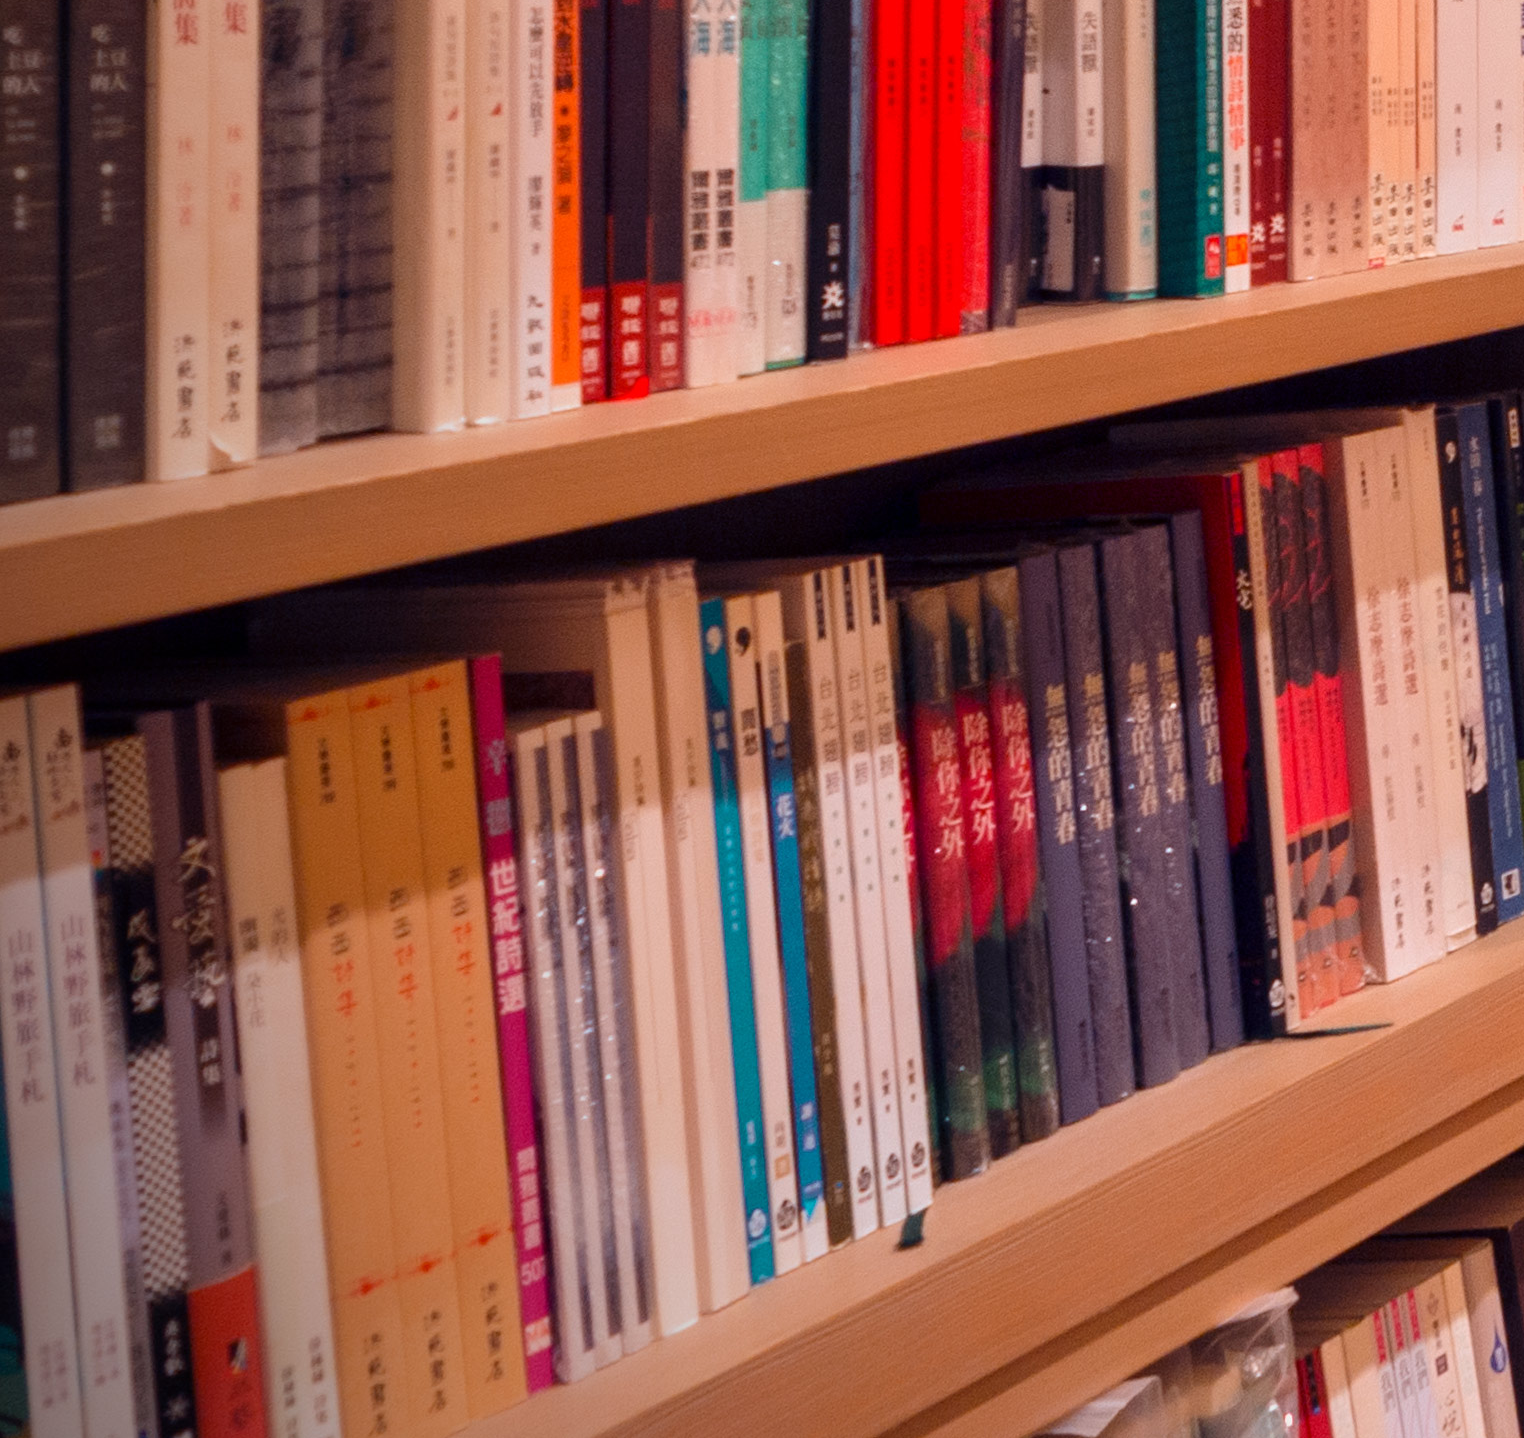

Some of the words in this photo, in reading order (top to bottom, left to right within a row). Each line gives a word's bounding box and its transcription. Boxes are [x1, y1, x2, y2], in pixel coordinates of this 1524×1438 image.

[930, 720, 965, 862] 除你之外
[962, 709, 997, 846] 除你之外
[1002, 699, 1036, 834] 除你之外
